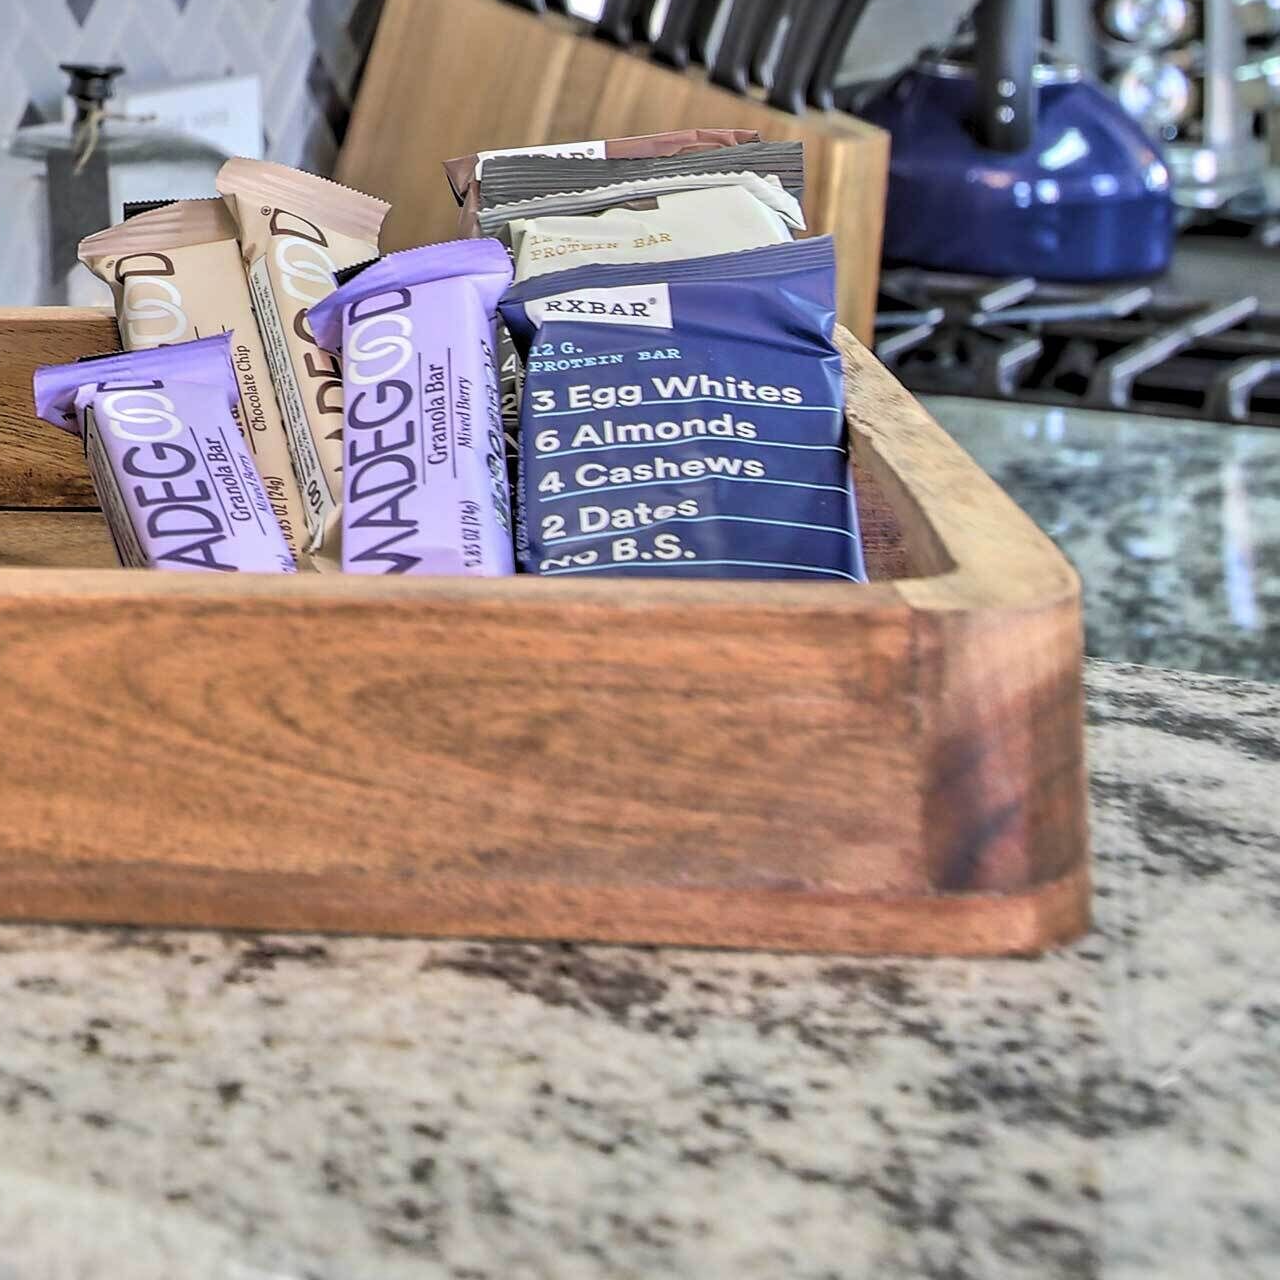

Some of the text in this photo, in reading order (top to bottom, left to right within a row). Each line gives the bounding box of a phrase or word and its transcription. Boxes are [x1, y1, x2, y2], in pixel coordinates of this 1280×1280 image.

[530, 232, 673, 261] PROTEIN BAR
[545, 298, 650, 318] RXBAR
[529, 341, 583, 358] 12 G.
[529, 348, 681, 373] PROTEIN BAR
[236, 345, 268, 432] Chocolate Chip
[531, 374, 804, 412] 3 Egg Whites
[425, 364, 448, 466] Granola Bar
[455, 376, 474, 449] Mixed Berry
[207, 437, 230, 462] Bar
[534, 428, 561, 452] 6
[571, 413, 758, 448] Almonds
[217, 463, 252, 522] Granola
[263, 475, 289, 503] (24g)
[537, 456, 766, 494] 4 Cashews
[541, 498, 700, 540] 2 Dates
[611, 532, 697, 562] B.S.
